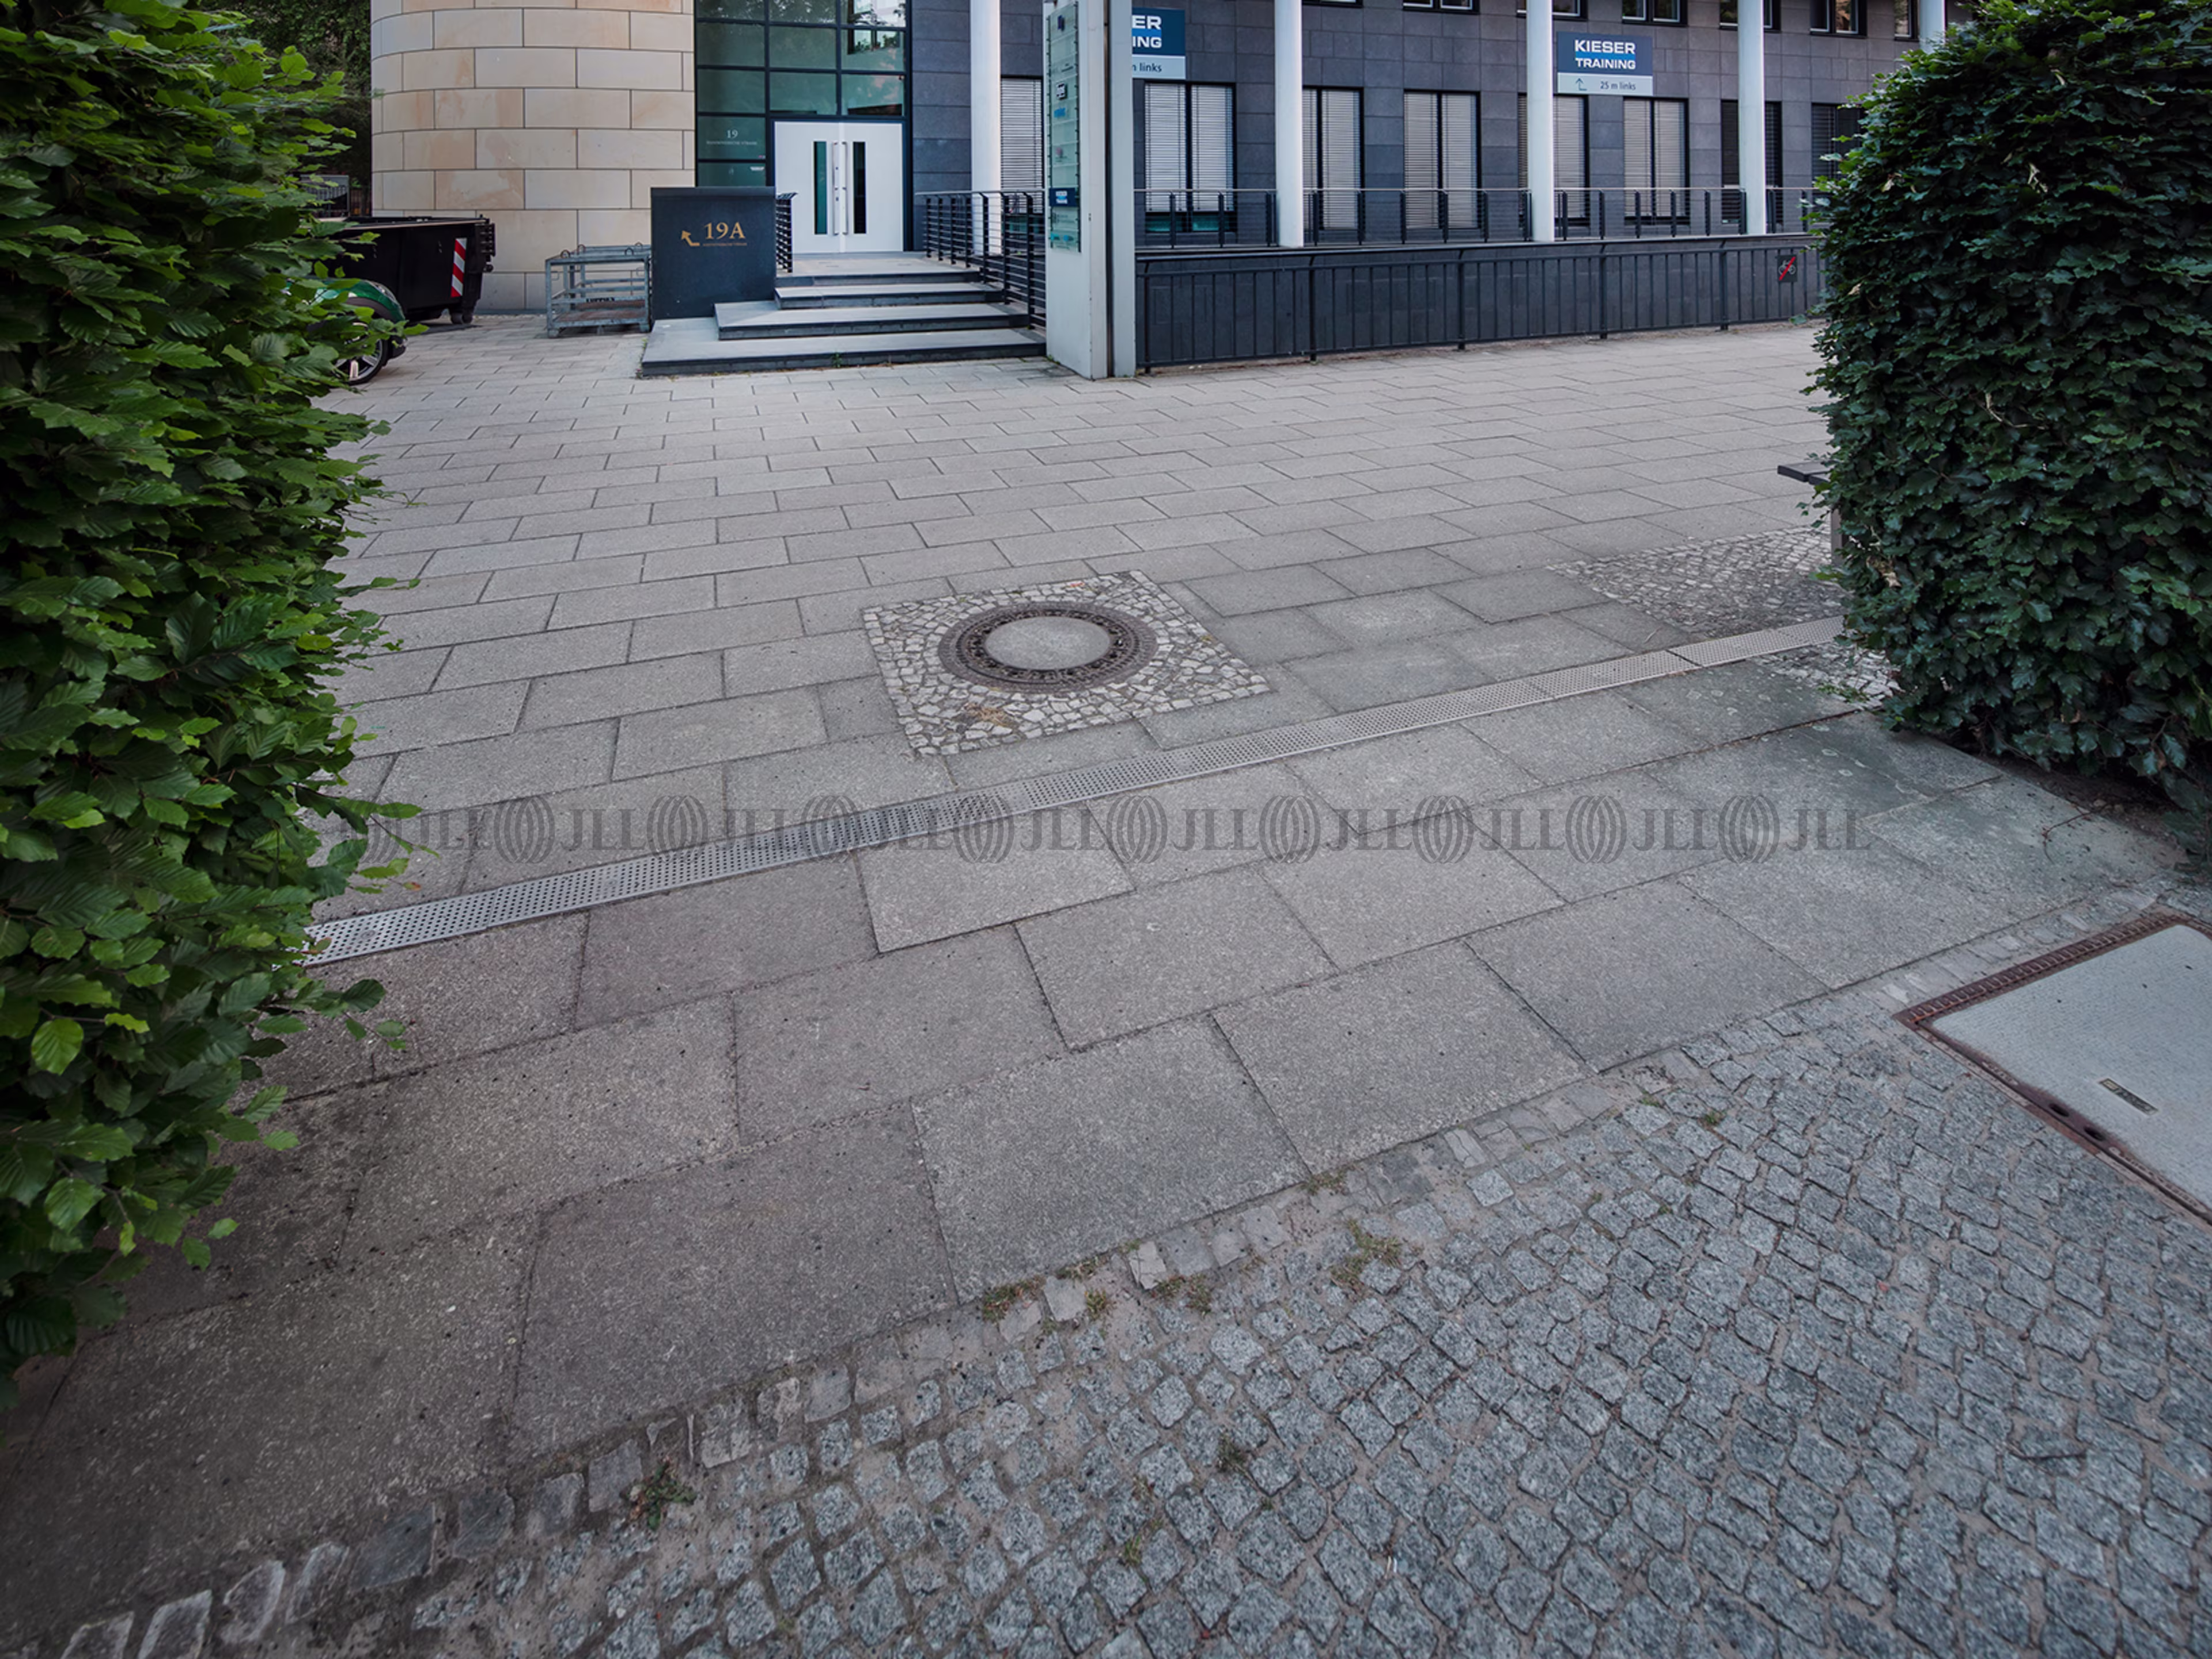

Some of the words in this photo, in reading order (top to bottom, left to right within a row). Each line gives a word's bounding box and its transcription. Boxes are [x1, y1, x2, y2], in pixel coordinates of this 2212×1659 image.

[1575, 39, 1635, 54] KIESER
[1139, 62, 1162, 72] links
[1575, 57, 1636, 69] TRAINING
[1600, 81, 1609, 90] 25
[1619, 81, 1636, 91] links
[727, 129, 738, 138] 19
[704, 222, 745, 240] 19A
